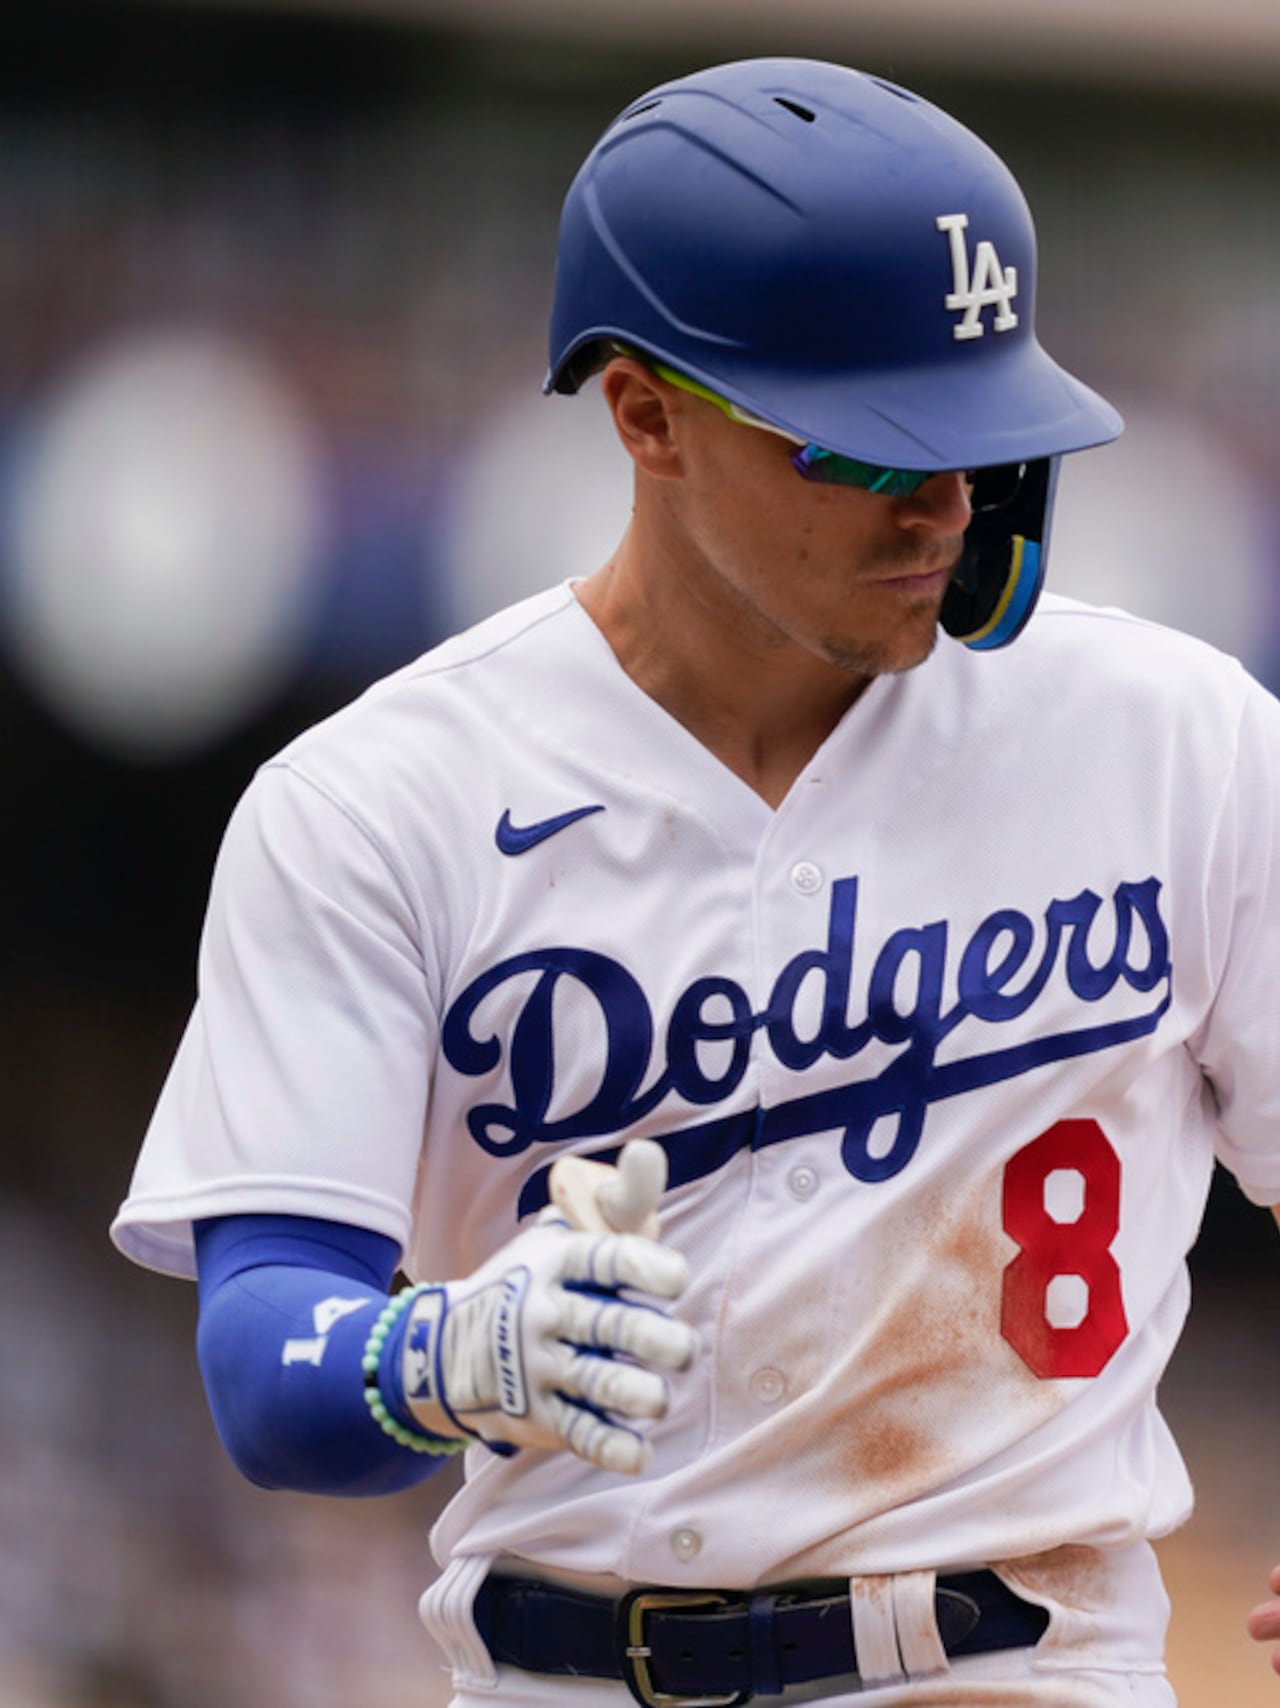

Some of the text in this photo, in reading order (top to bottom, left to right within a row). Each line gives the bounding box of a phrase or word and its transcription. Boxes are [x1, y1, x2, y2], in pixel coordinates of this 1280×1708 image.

[936, 213, 1018, 340] LA
[442, 875, 1172, 1184] Dodgers
[1000, 1117, 1130, 1380] 8
